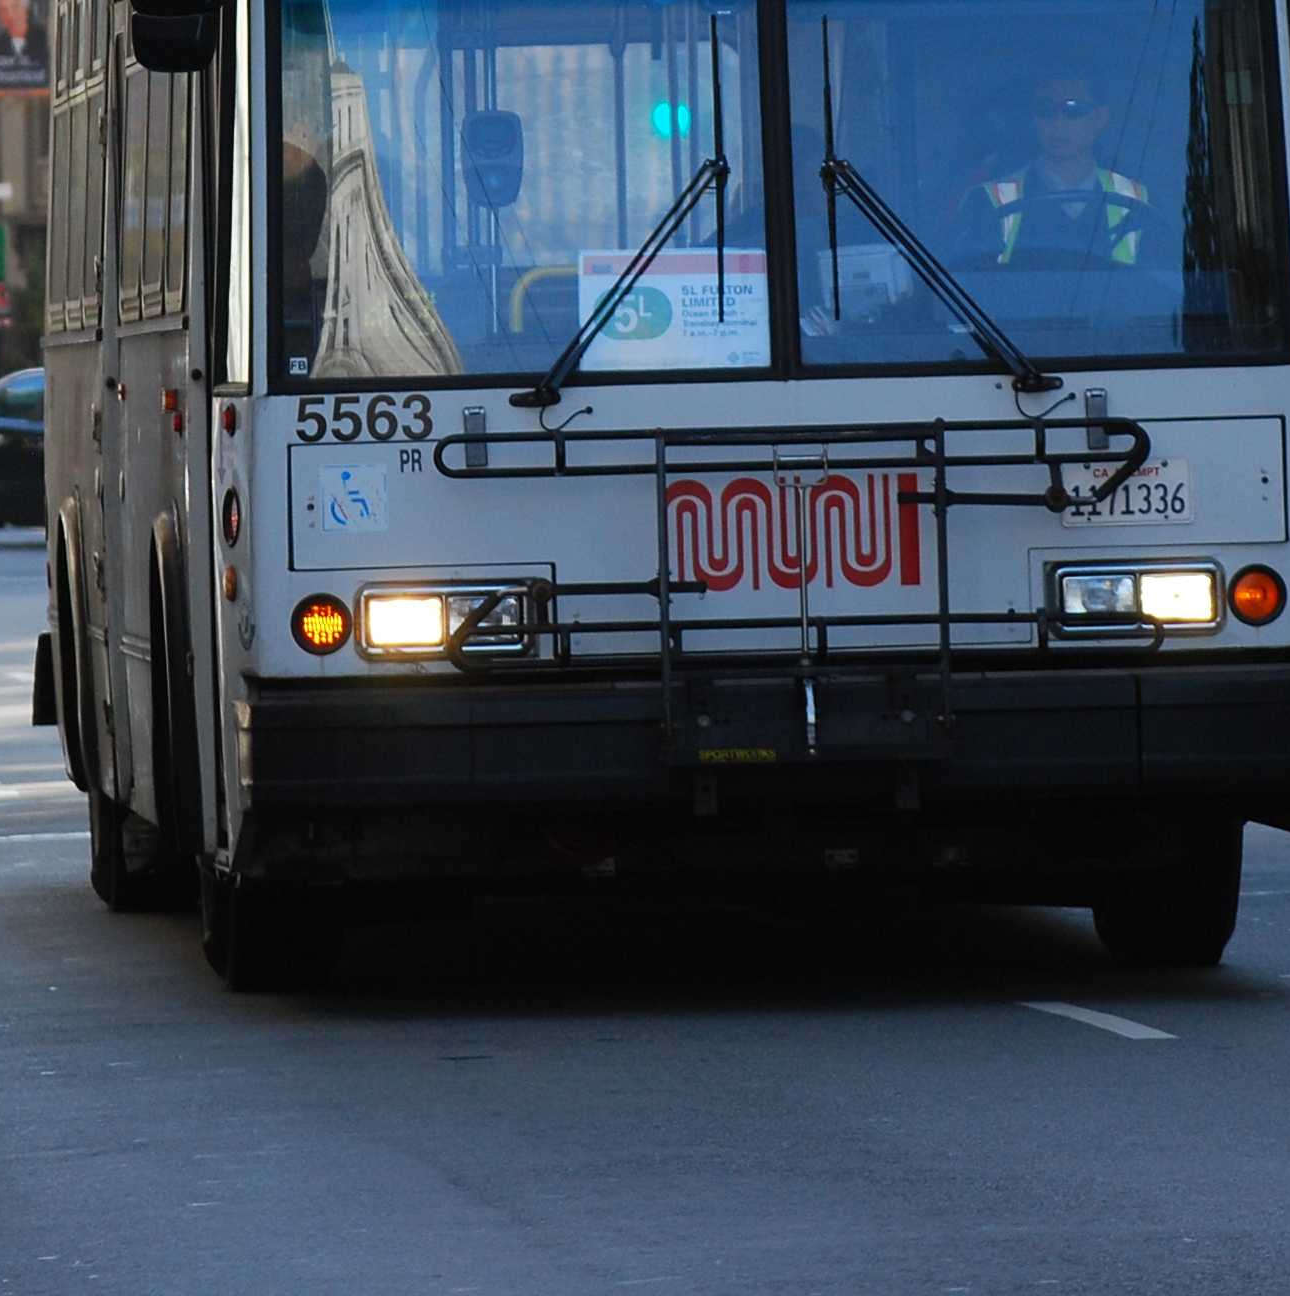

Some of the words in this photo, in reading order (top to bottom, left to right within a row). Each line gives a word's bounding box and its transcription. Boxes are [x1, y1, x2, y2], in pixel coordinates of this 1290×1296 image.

[681, 285, 698, 296] 5L
[701, 284, 753, 296] FUTON
[681, 296, 736, 308] LIMITD
[613, 294, 652, 333] 5L
[290, 360, 307, 371] FB
[295, 394, 434, 443] 5563
[399, 449, 423, 473] PR
[1092, 468, 1109, 478] CA
